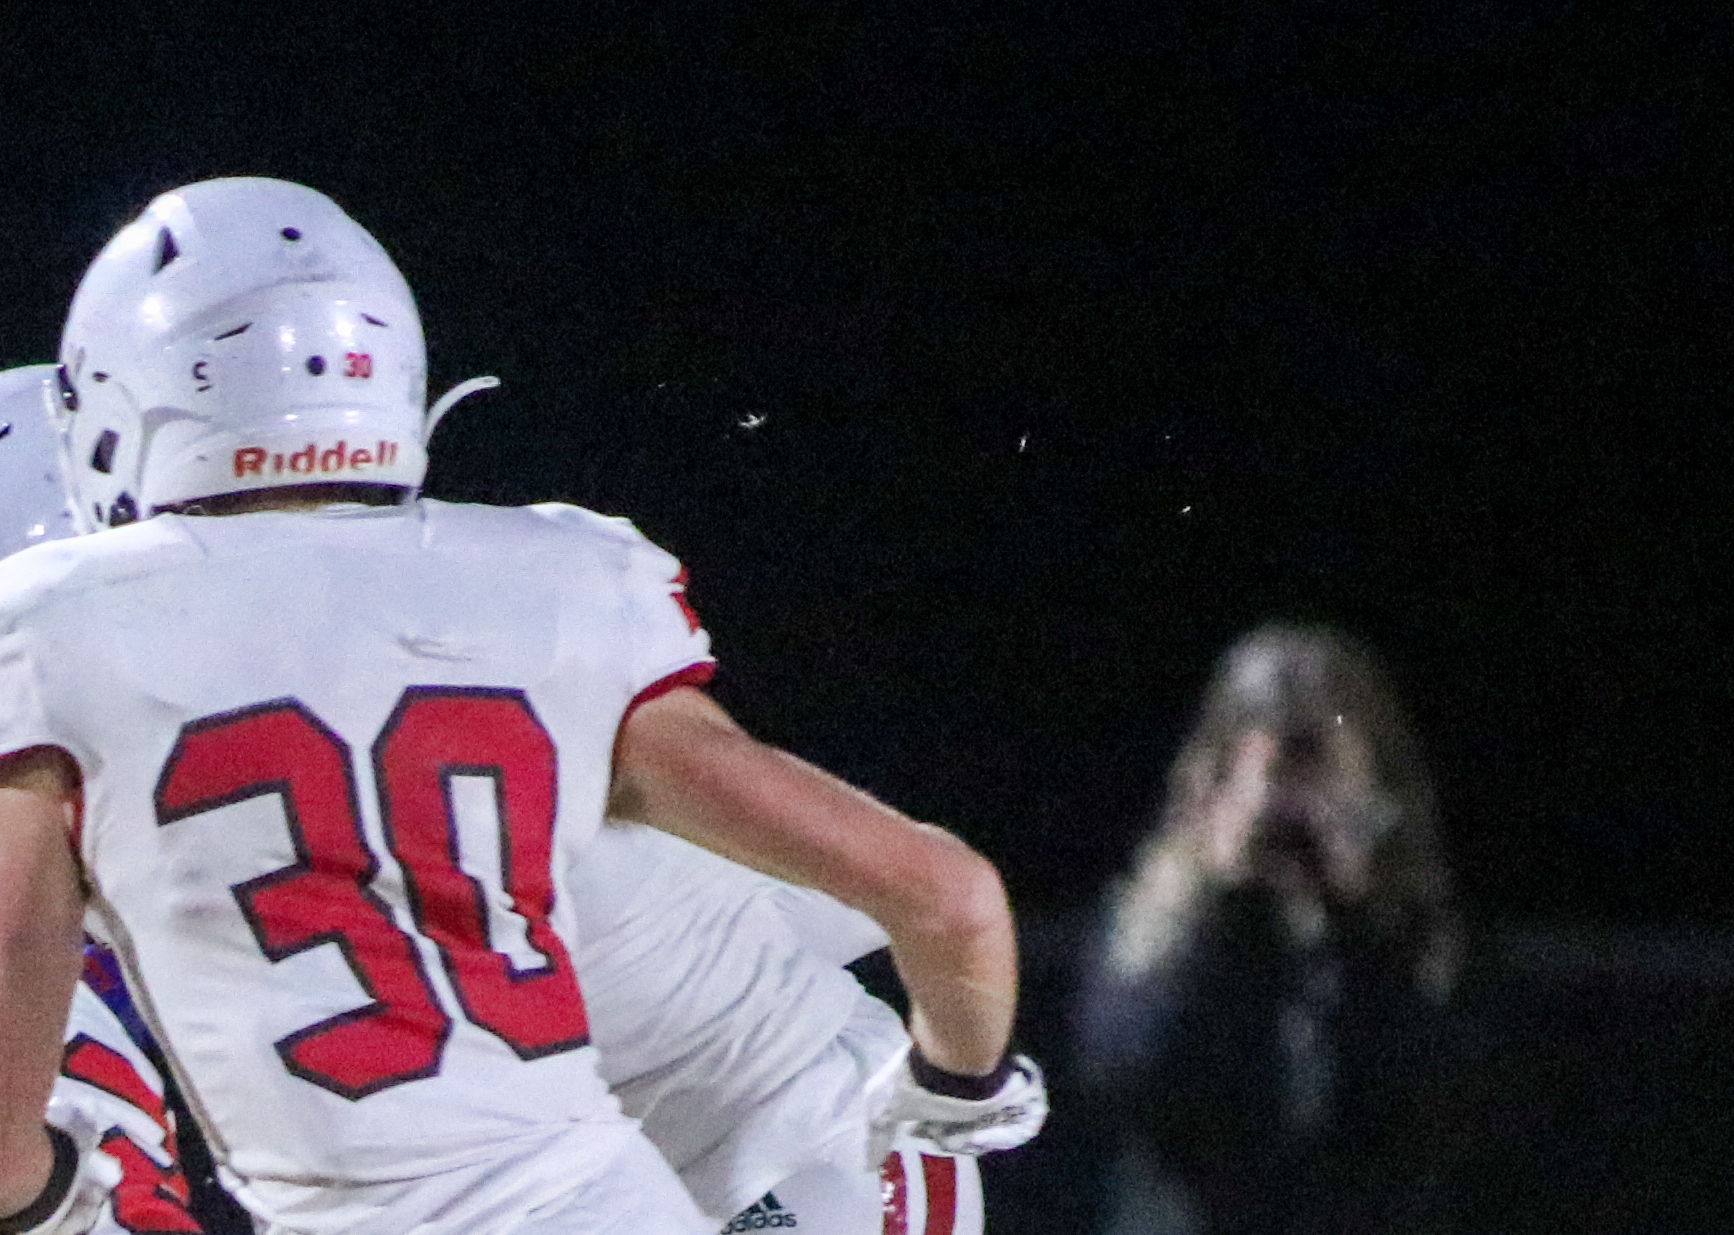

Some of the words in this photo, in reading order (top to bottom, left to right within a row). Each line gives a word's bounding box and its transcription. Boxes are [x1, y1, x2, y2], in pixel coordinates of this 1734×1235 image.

[344, 352, 372, 379] 30
[234, 440, 398, 478] Riddell
[153, 684, 591, 1102] 30
